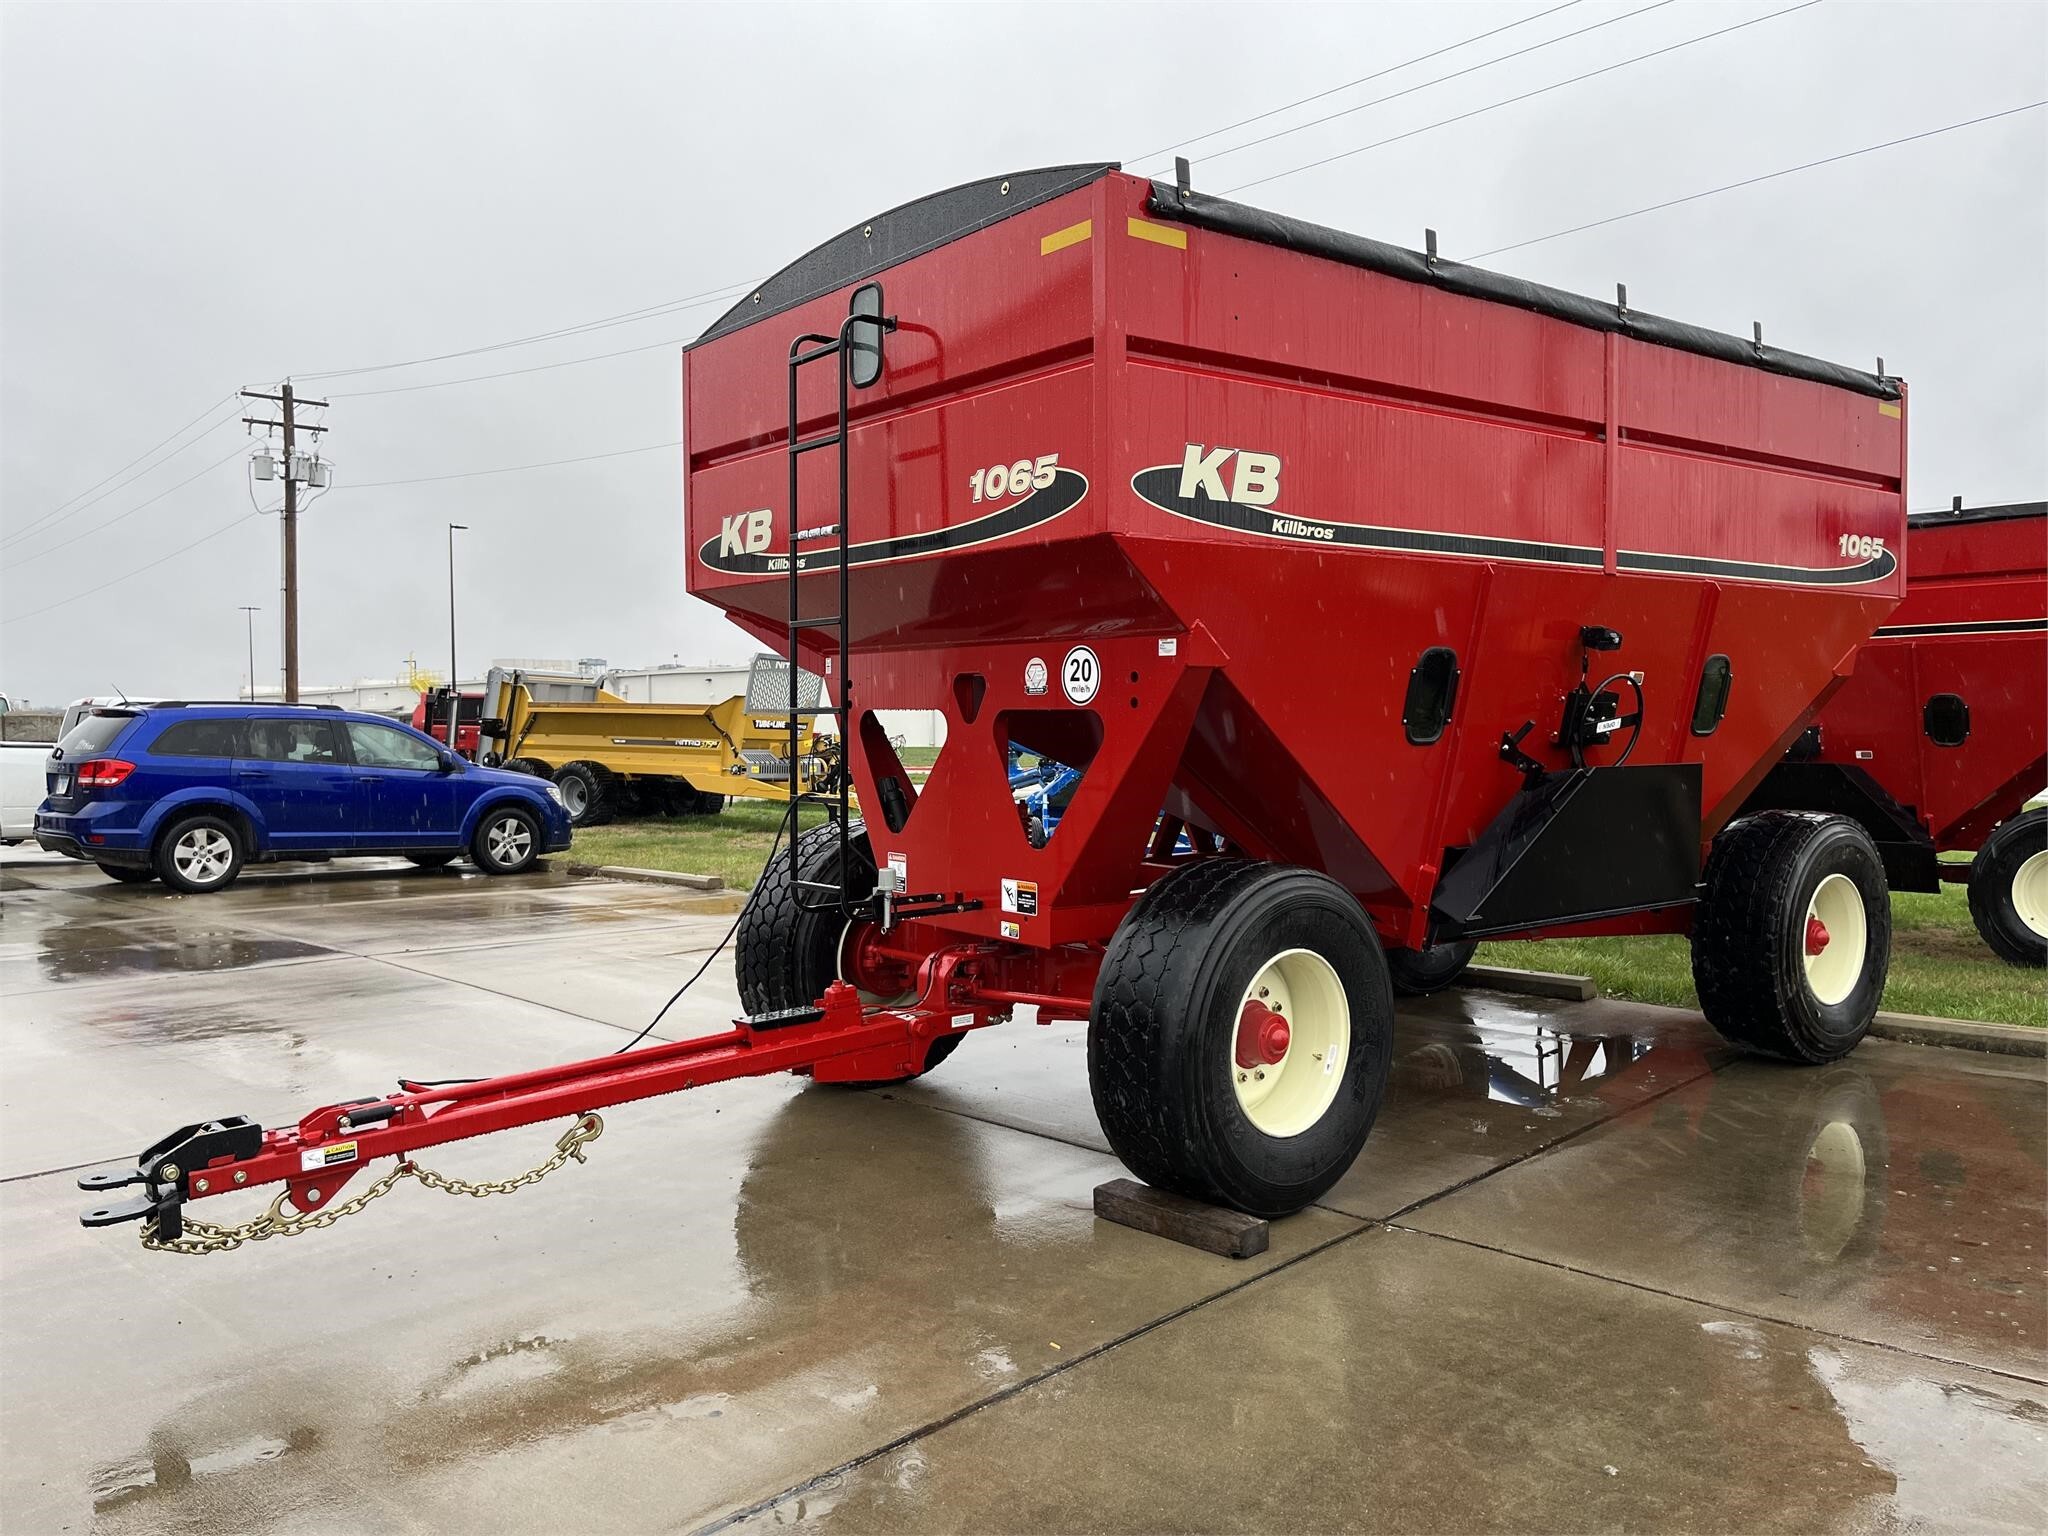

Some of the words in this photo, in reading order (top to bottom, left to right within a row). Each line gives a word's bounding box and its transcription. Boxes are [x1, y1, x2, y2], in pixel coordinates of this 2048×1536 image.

[969, 453, 1059, 504] 1065
[1178, 442, 1281, 506] KB
[720, 509, 773, 558] KB
[1271, 518, 1335, 540] Killbros
[1838, 533, 1884, 560] 1065
[767, 557, 807, 571] Killbs
[1070, 658, 1092, 682] 20
[331, 1144, 355, 1152] CAUTION
